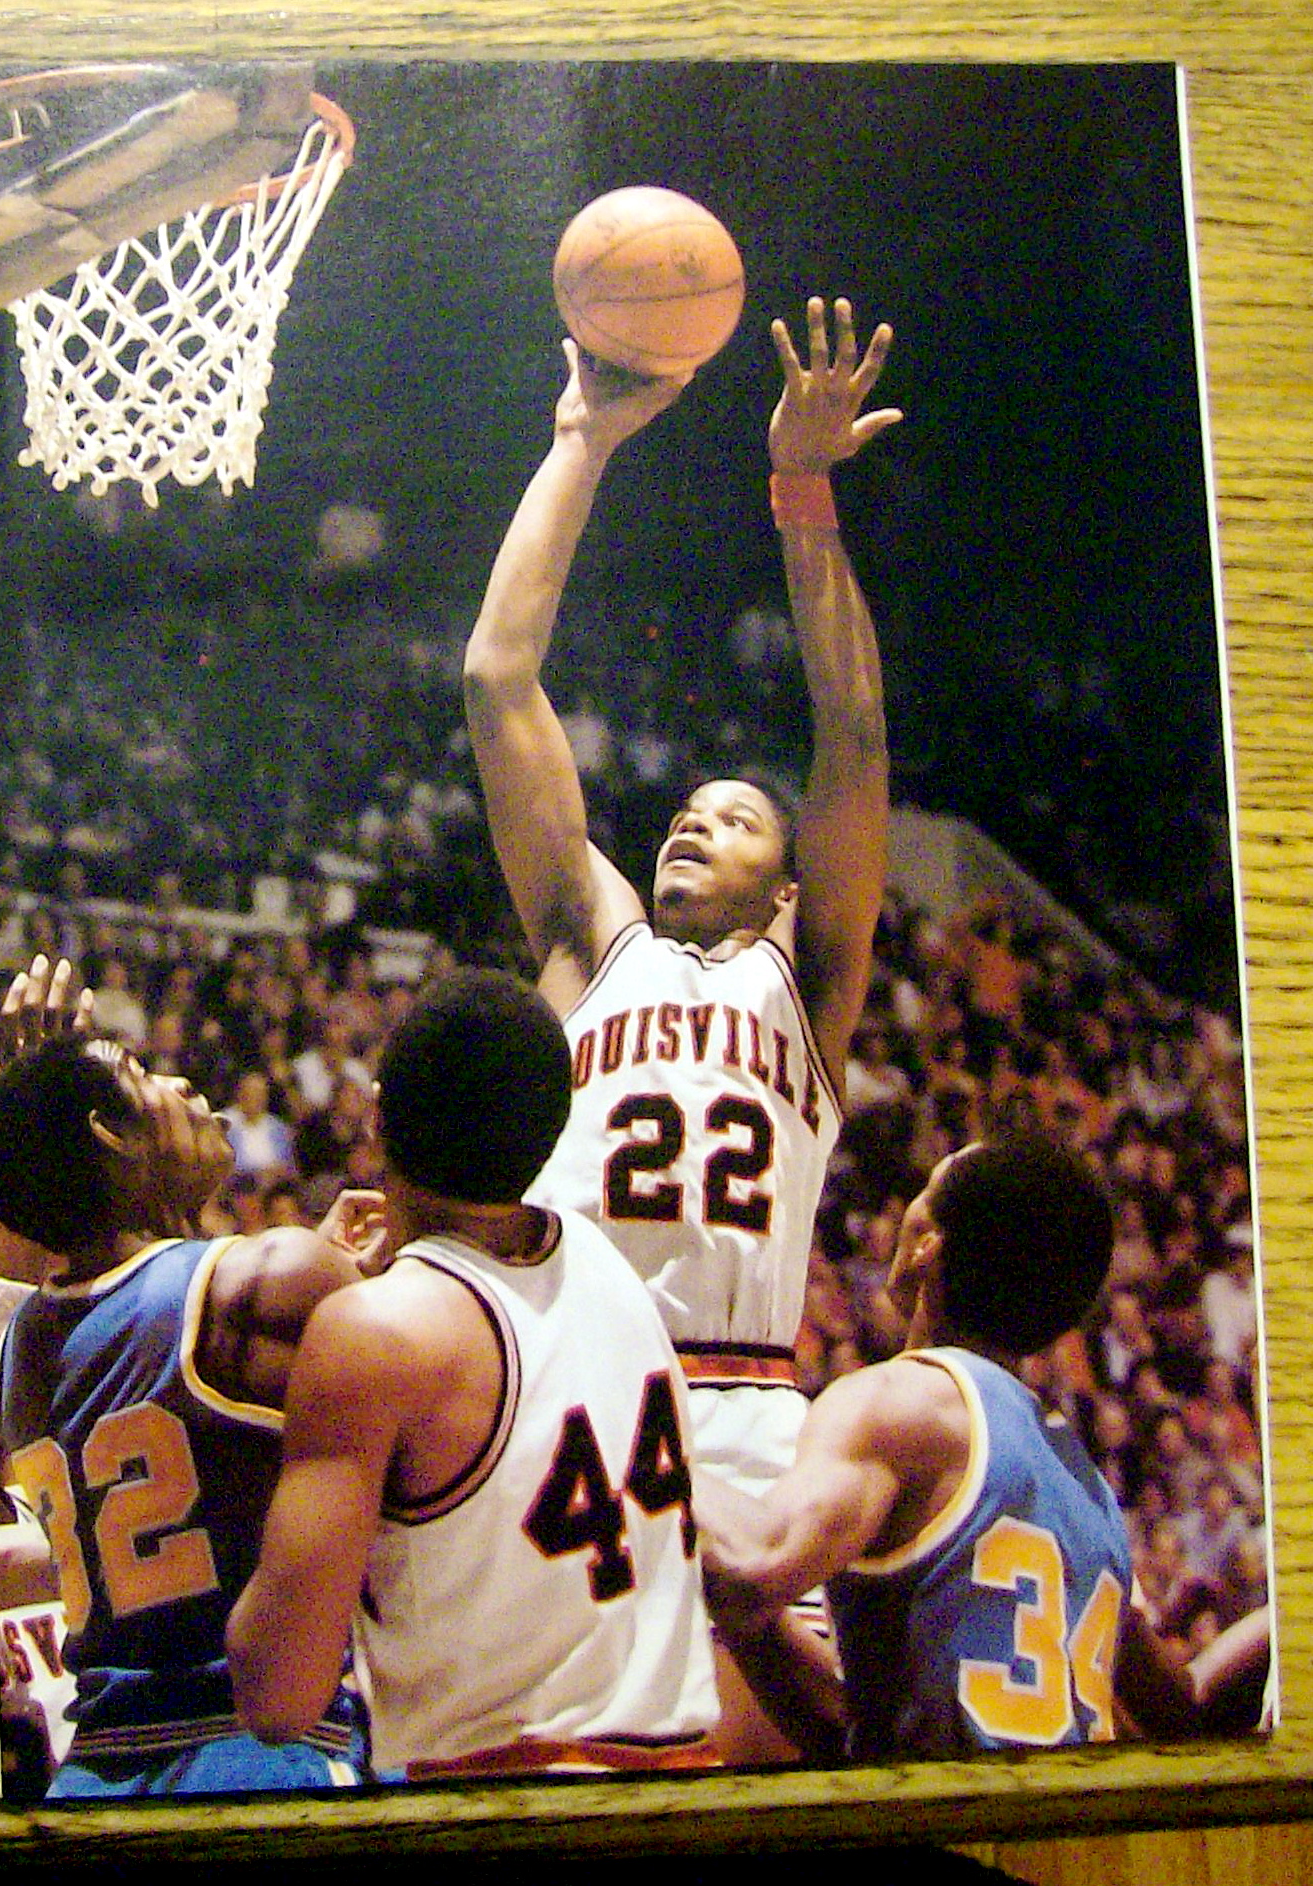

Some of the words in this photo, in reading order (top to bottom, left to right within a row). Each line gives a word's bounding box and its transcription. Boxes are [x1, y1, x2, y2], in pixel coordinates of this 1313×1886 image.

[572, 1002, 820, 1139] OUISVILLE
[602, 1092, 775, 1238] 22
[522, 1369, 699, 1604] 44
[957, 1514, 1123, 1746] 34
